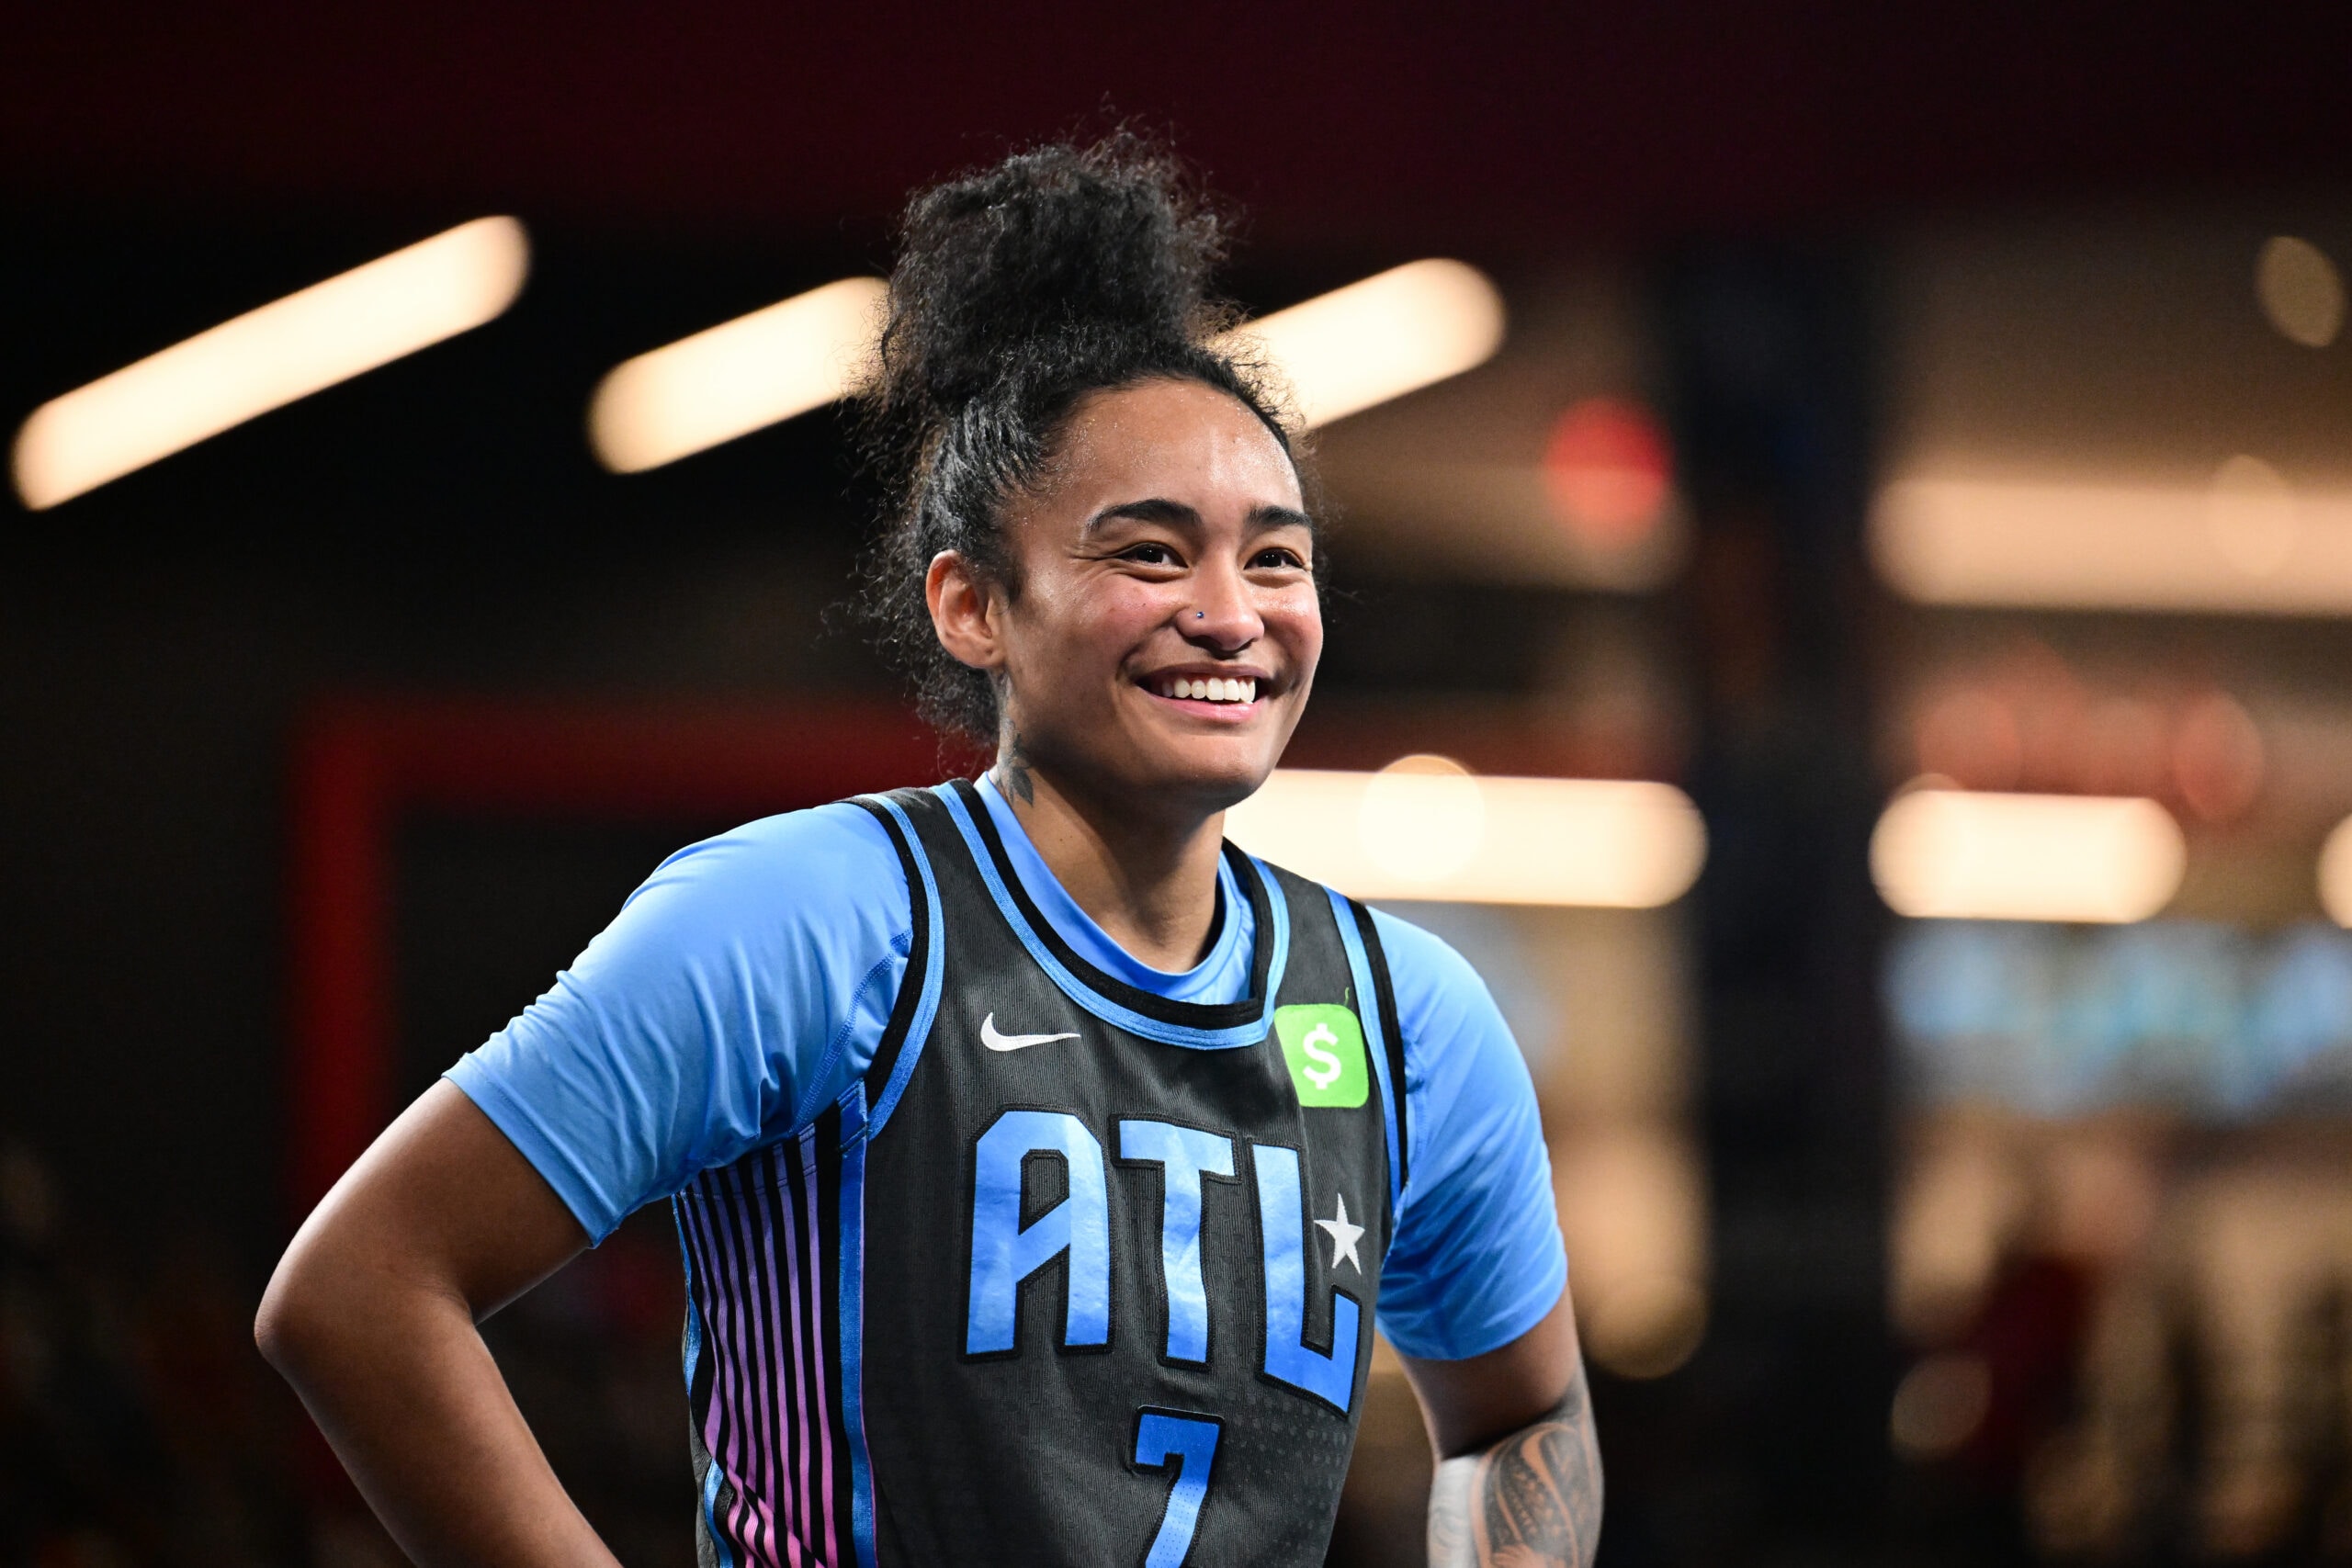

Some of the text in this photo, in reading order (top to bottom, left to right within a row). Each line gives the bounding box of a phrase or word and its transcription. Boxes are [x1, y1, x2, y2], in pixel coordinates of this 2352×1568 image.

[1302, 1022, 1341, 1089] $
[965, 1110, 1363, 1416] ATL
[1133, 1411, 1223, 1568] 7
